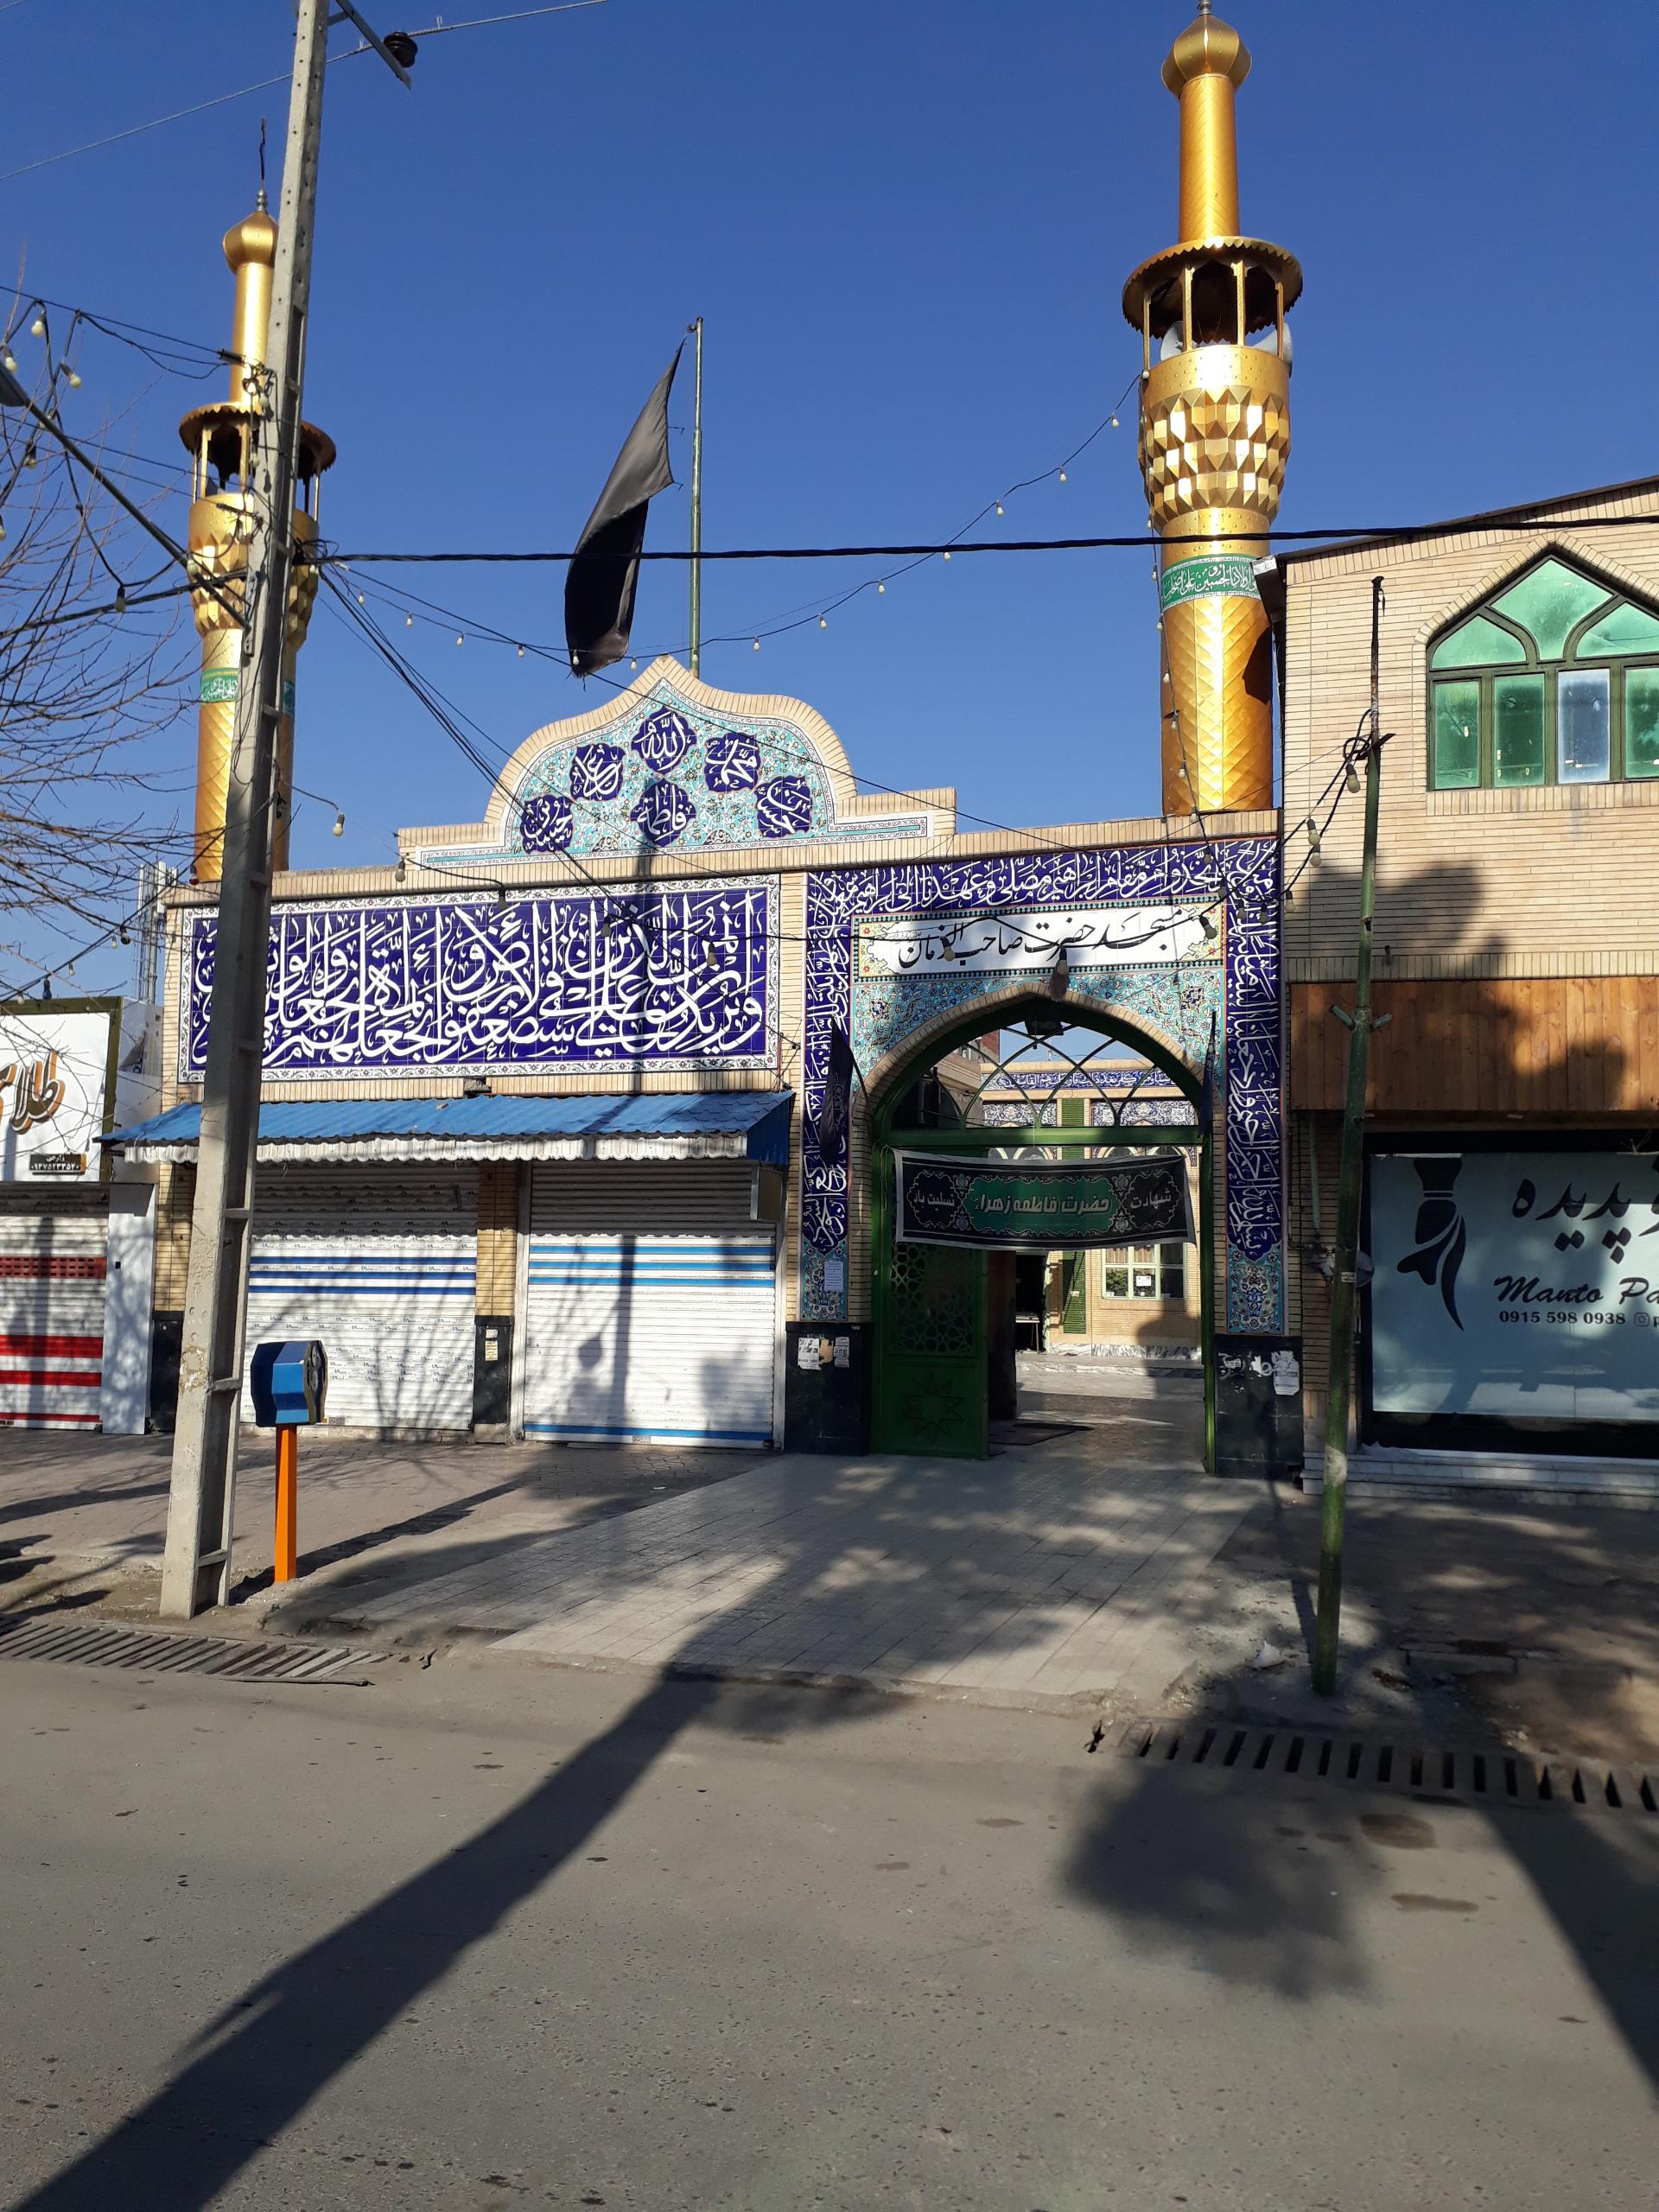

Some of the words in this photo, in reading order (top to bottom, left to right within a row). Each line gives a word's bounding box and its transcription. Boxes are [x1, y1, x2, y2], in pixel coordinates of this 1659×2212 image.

[1013, 1195, 1059, 1214] فاطمه
[1060, 1195, 1110, 1217] حضرت
[1130, 1190, 1172, 1210] شهادت
[1493, 1274, 1605, 1305] Manto
[1499, 1310, 1541, 1325] 0915
[1547, 1310, 1578, 1325] 598
[1583, 1312, 1626, 1325] 0938
